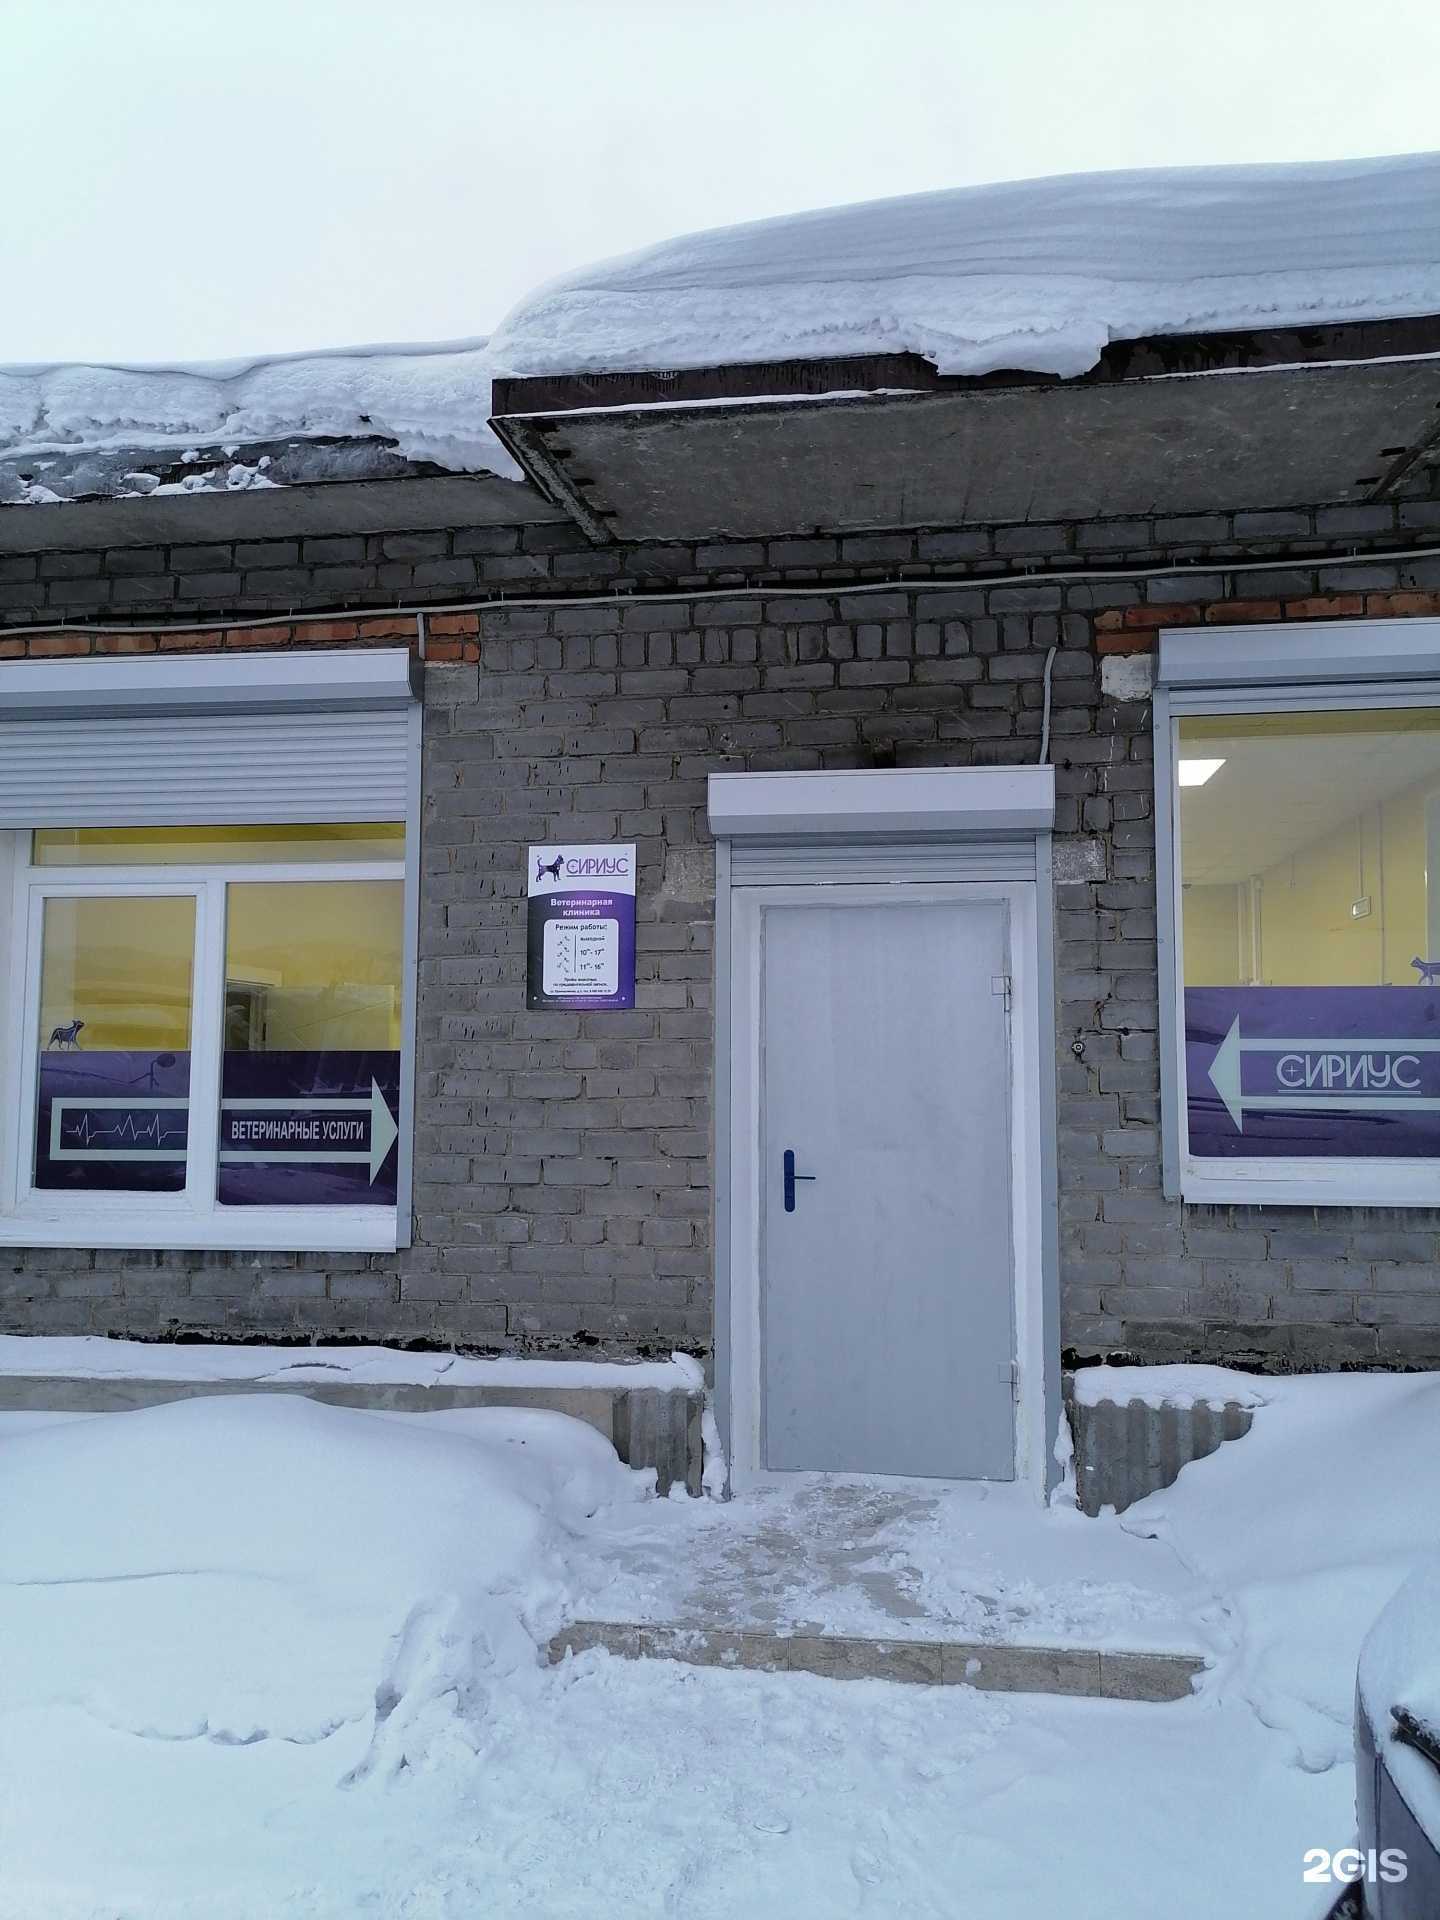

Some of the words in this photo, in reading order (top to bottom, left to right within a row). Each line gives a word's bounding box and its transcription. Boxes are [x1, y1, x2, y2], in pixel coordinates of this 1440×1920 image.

[566, 857, 629, 875] СИРИУС
[550, 898, 613, 908] Ветеринарная
[1276, 1054, 1421, 1088] СИРИУС
[231, 1120, 320, 1140] ВЕТЕРИНАРНЫЕ
[322, 1120, 364, 1140] УСЛУГИ
